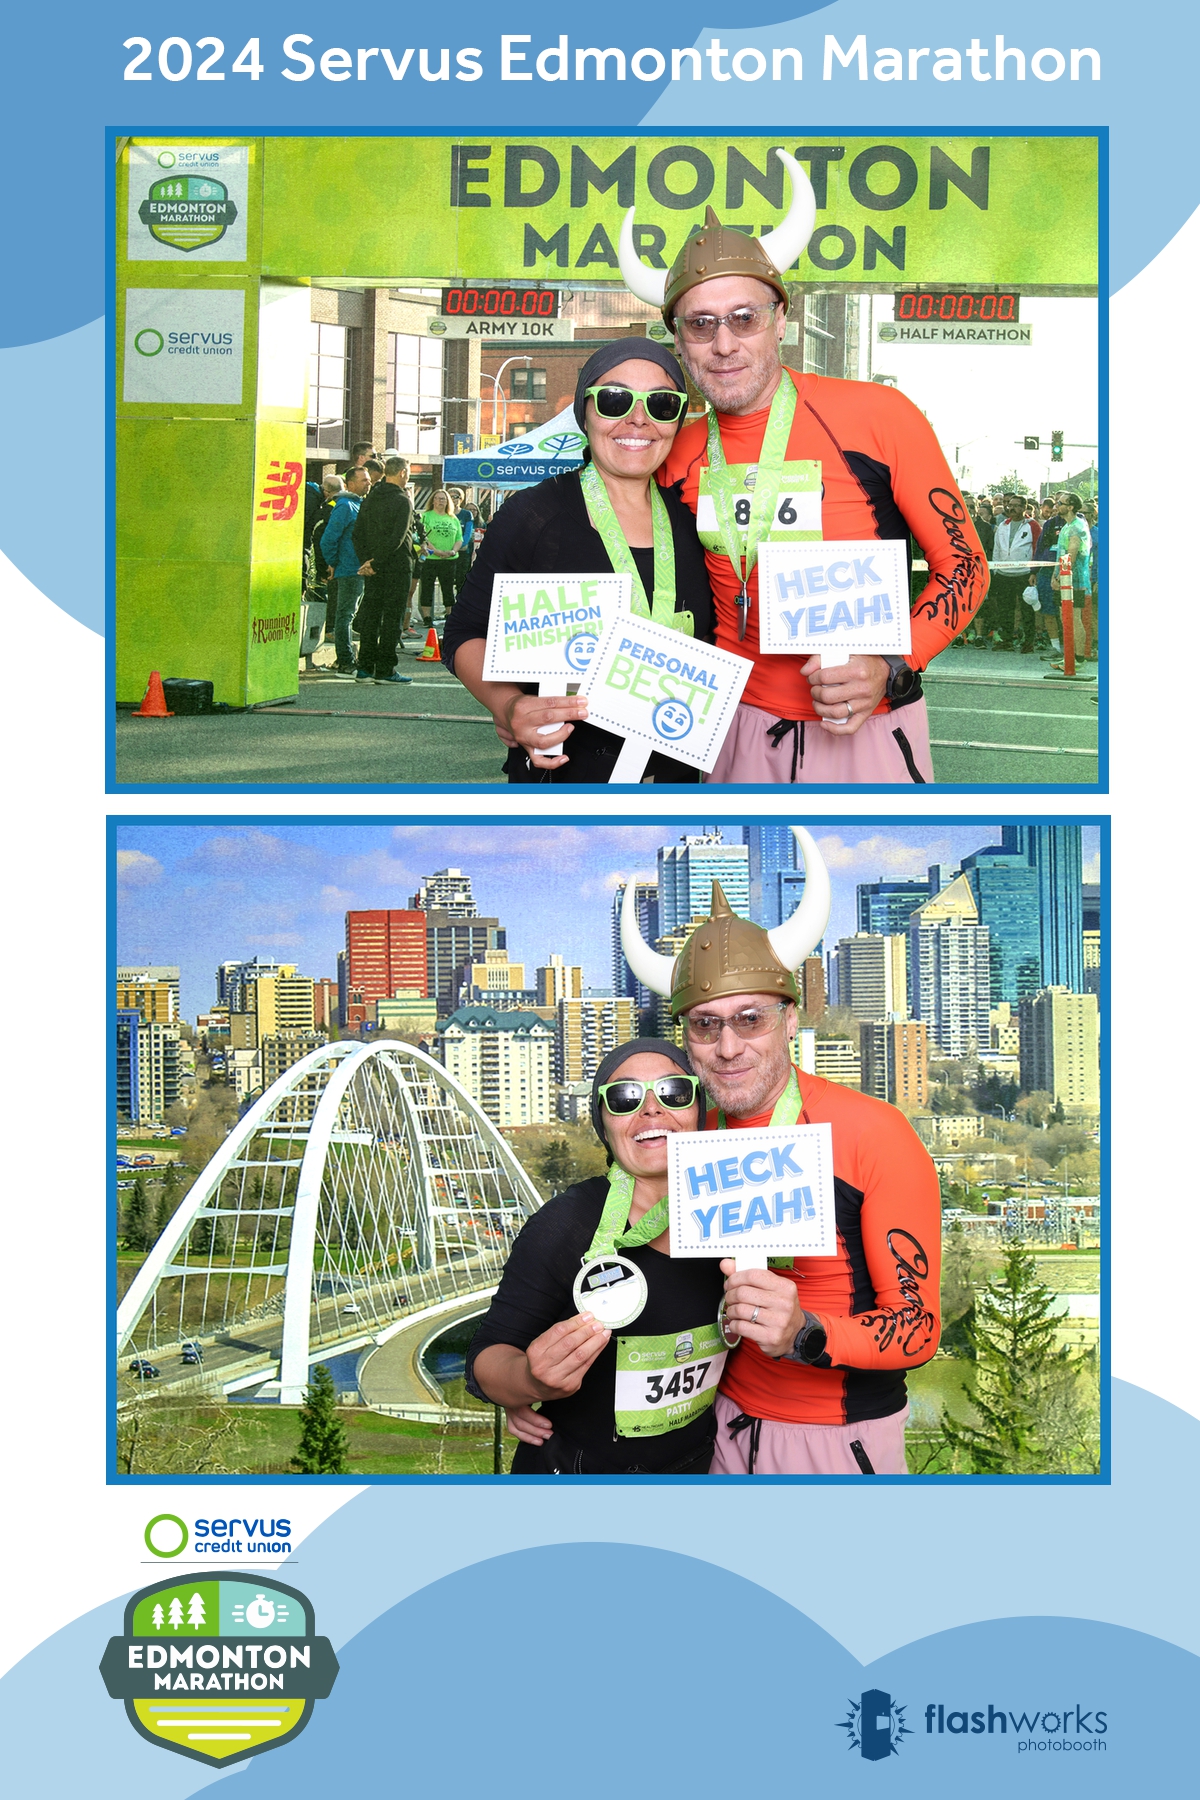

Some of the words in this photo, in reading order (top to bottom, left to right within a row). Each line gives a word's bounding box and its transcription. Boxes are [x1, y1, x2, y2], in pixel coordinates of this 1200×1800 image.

[178, 151, 220, 161] servus
[450, 145, 990, 212] EDMONTON
[149, 203, 227, 213] EDMONTON
[160, 214, 215, 222] MARATHON
[168, 331, 233, 345] servus
[465, 321, 518, 335] ARMY
[521, 322, 554, 337] 10K
[900, 328, 939, 339] HALF
[942, 328, 1031, 341] MARATHON
[168, 345, 200, 355] credit
[202, 347, 233, 355] union
[496, 465, 545, 475] servus
[774, 555, 882, 602] HECK
[501, 579, 600, 621] HALF
[257, 613, 290, 638] Running
[503, 605, 601, 634] MARATHON
[779, 593, 894, 640] YEAH!
[257, 618, 284, 643] Room
[503, 619, 604, 652] FINISHER!
[618, 637, 719, 690] PERSONAL
[604, 653, 716, 724] BEST!
[684, 1143, 804, 1200] HECK
[690, 1185, 816, 1242] YEAH!
[645, 1361, 712, 1404] 3457
[666, 1401, 693, 1418] PATTY
[668, 1417, 684, 1427] HALF
[684, 1404, 709, 1422] MARATHON
